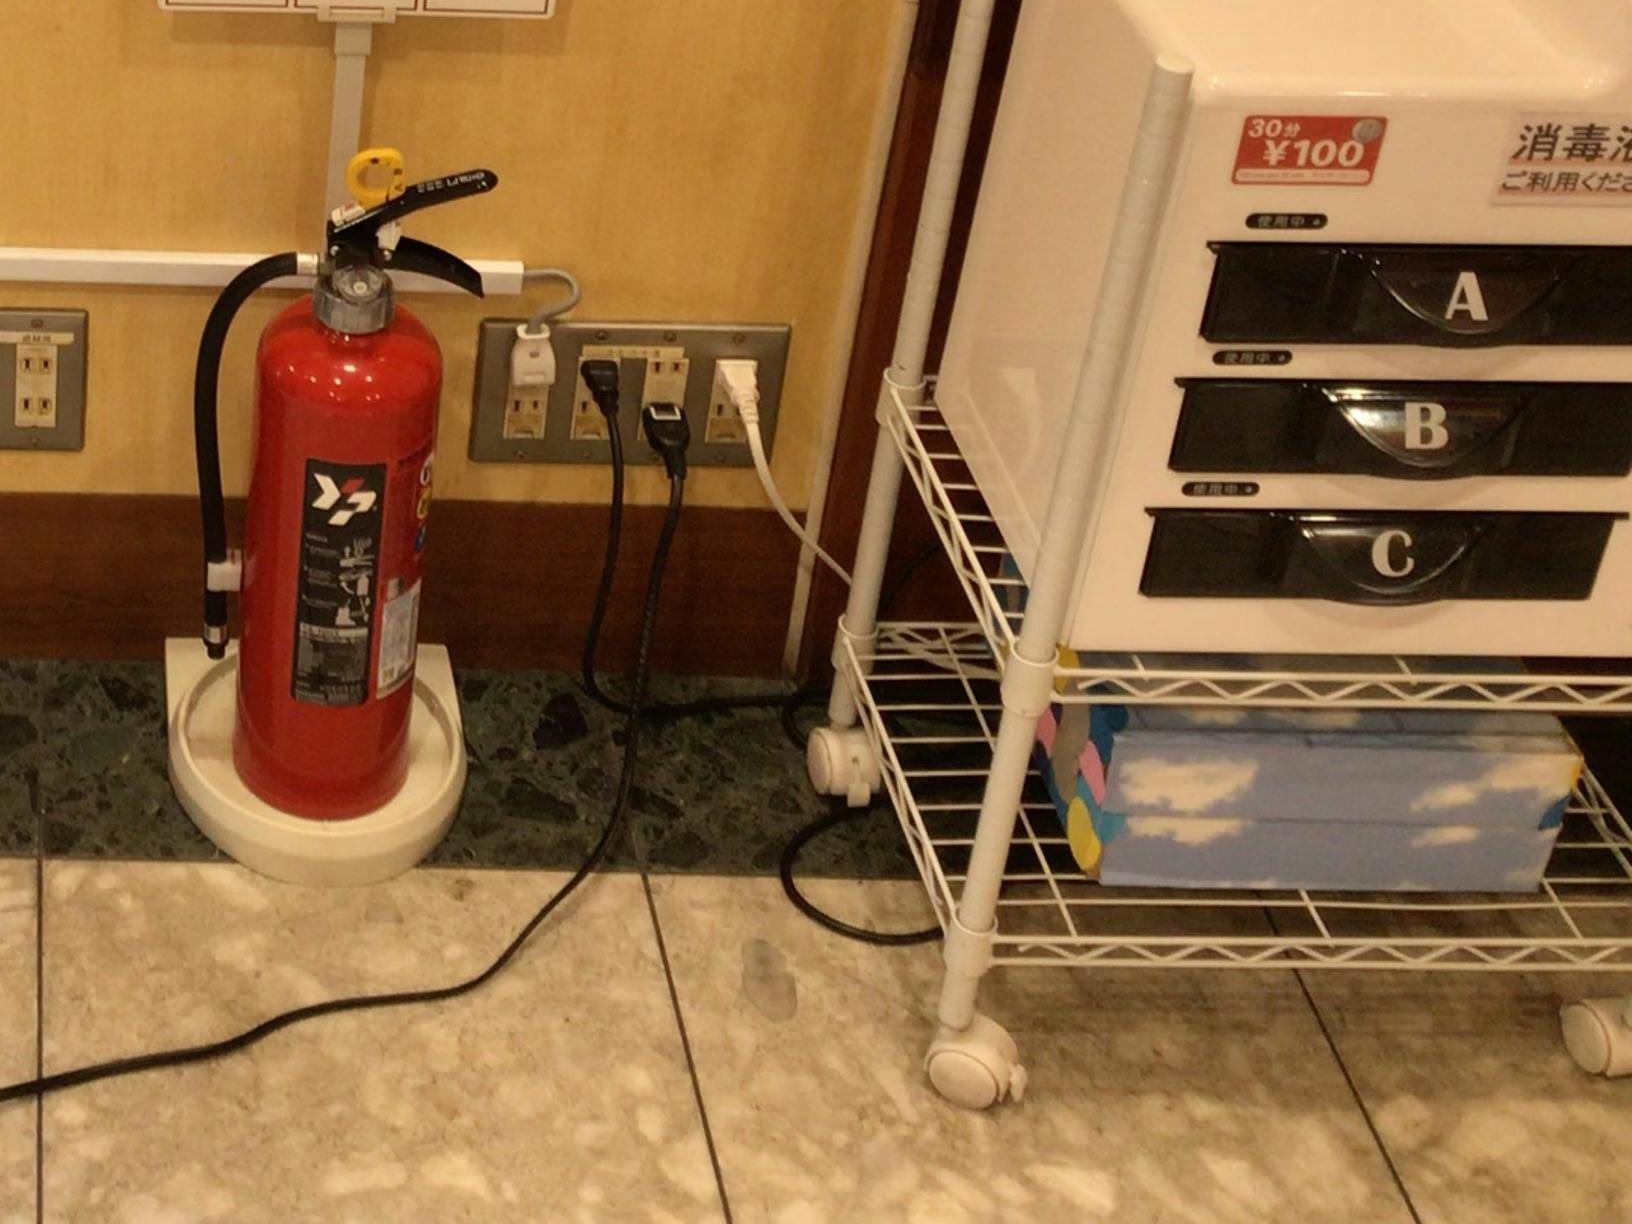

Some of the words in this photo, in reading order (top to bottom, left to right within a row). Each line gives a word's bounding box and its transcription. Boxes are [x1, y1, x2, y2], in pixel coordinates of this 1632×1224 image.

[1248, 118, 1301, 138] 30分
[1263, 139, 1365, 167] ¥100
[1257, 215, 1306, 228] 使用中
[1444, 271, 1489, 321] A
[1223, 353, 1270, 365] 使用中
[1404, 402, 1448, 450] B
[1371, 529, 1415, 577] C
